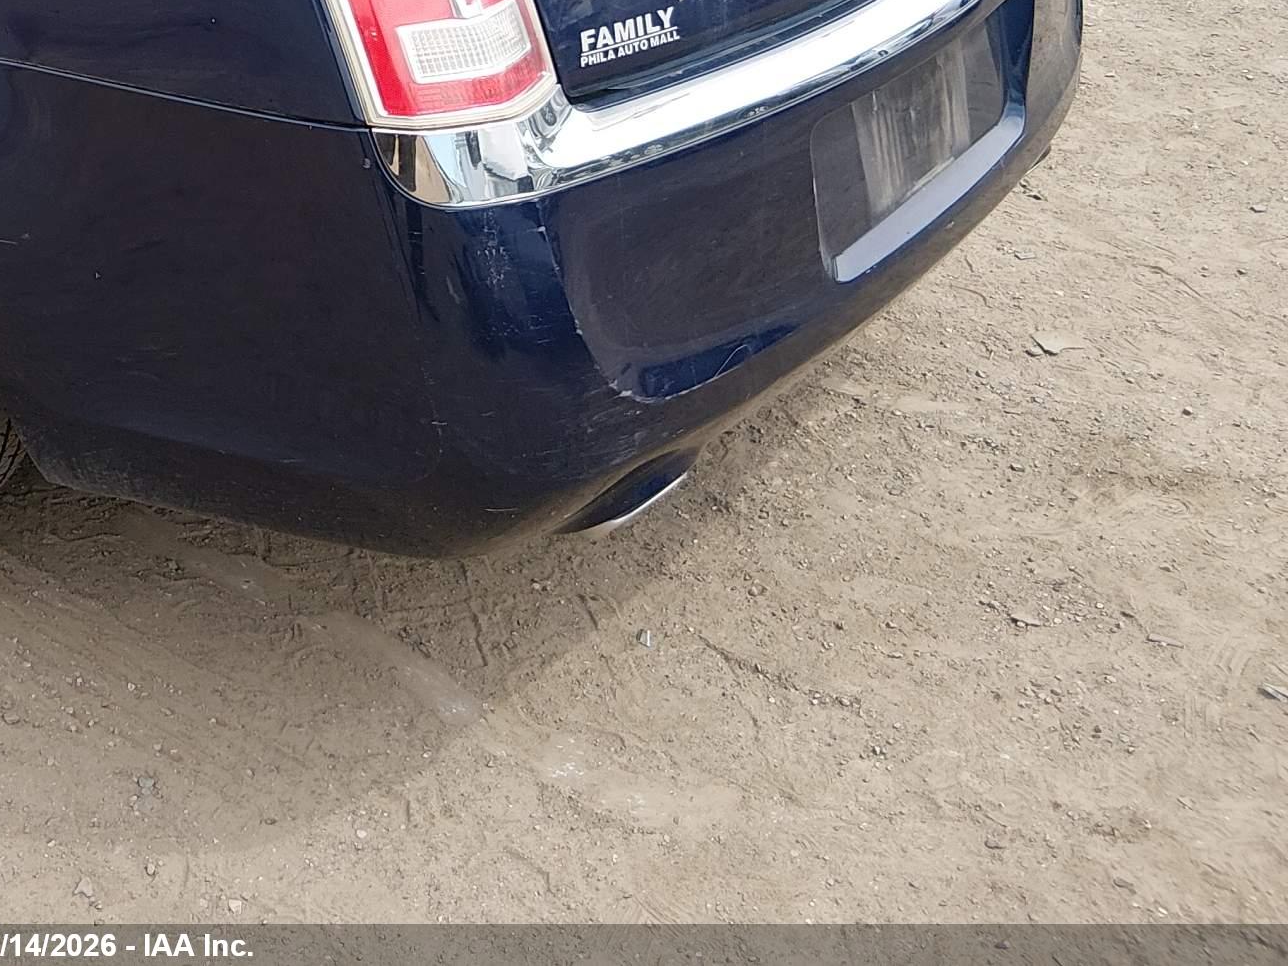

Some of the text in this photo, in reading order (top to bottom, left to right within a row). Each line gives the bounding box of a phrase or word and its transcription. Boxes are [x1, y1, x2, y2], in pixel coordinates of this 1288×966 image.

[580, 6, 675, 53] FAMILY
[580, 30, 681, 68] PHILA AUTO MALL
